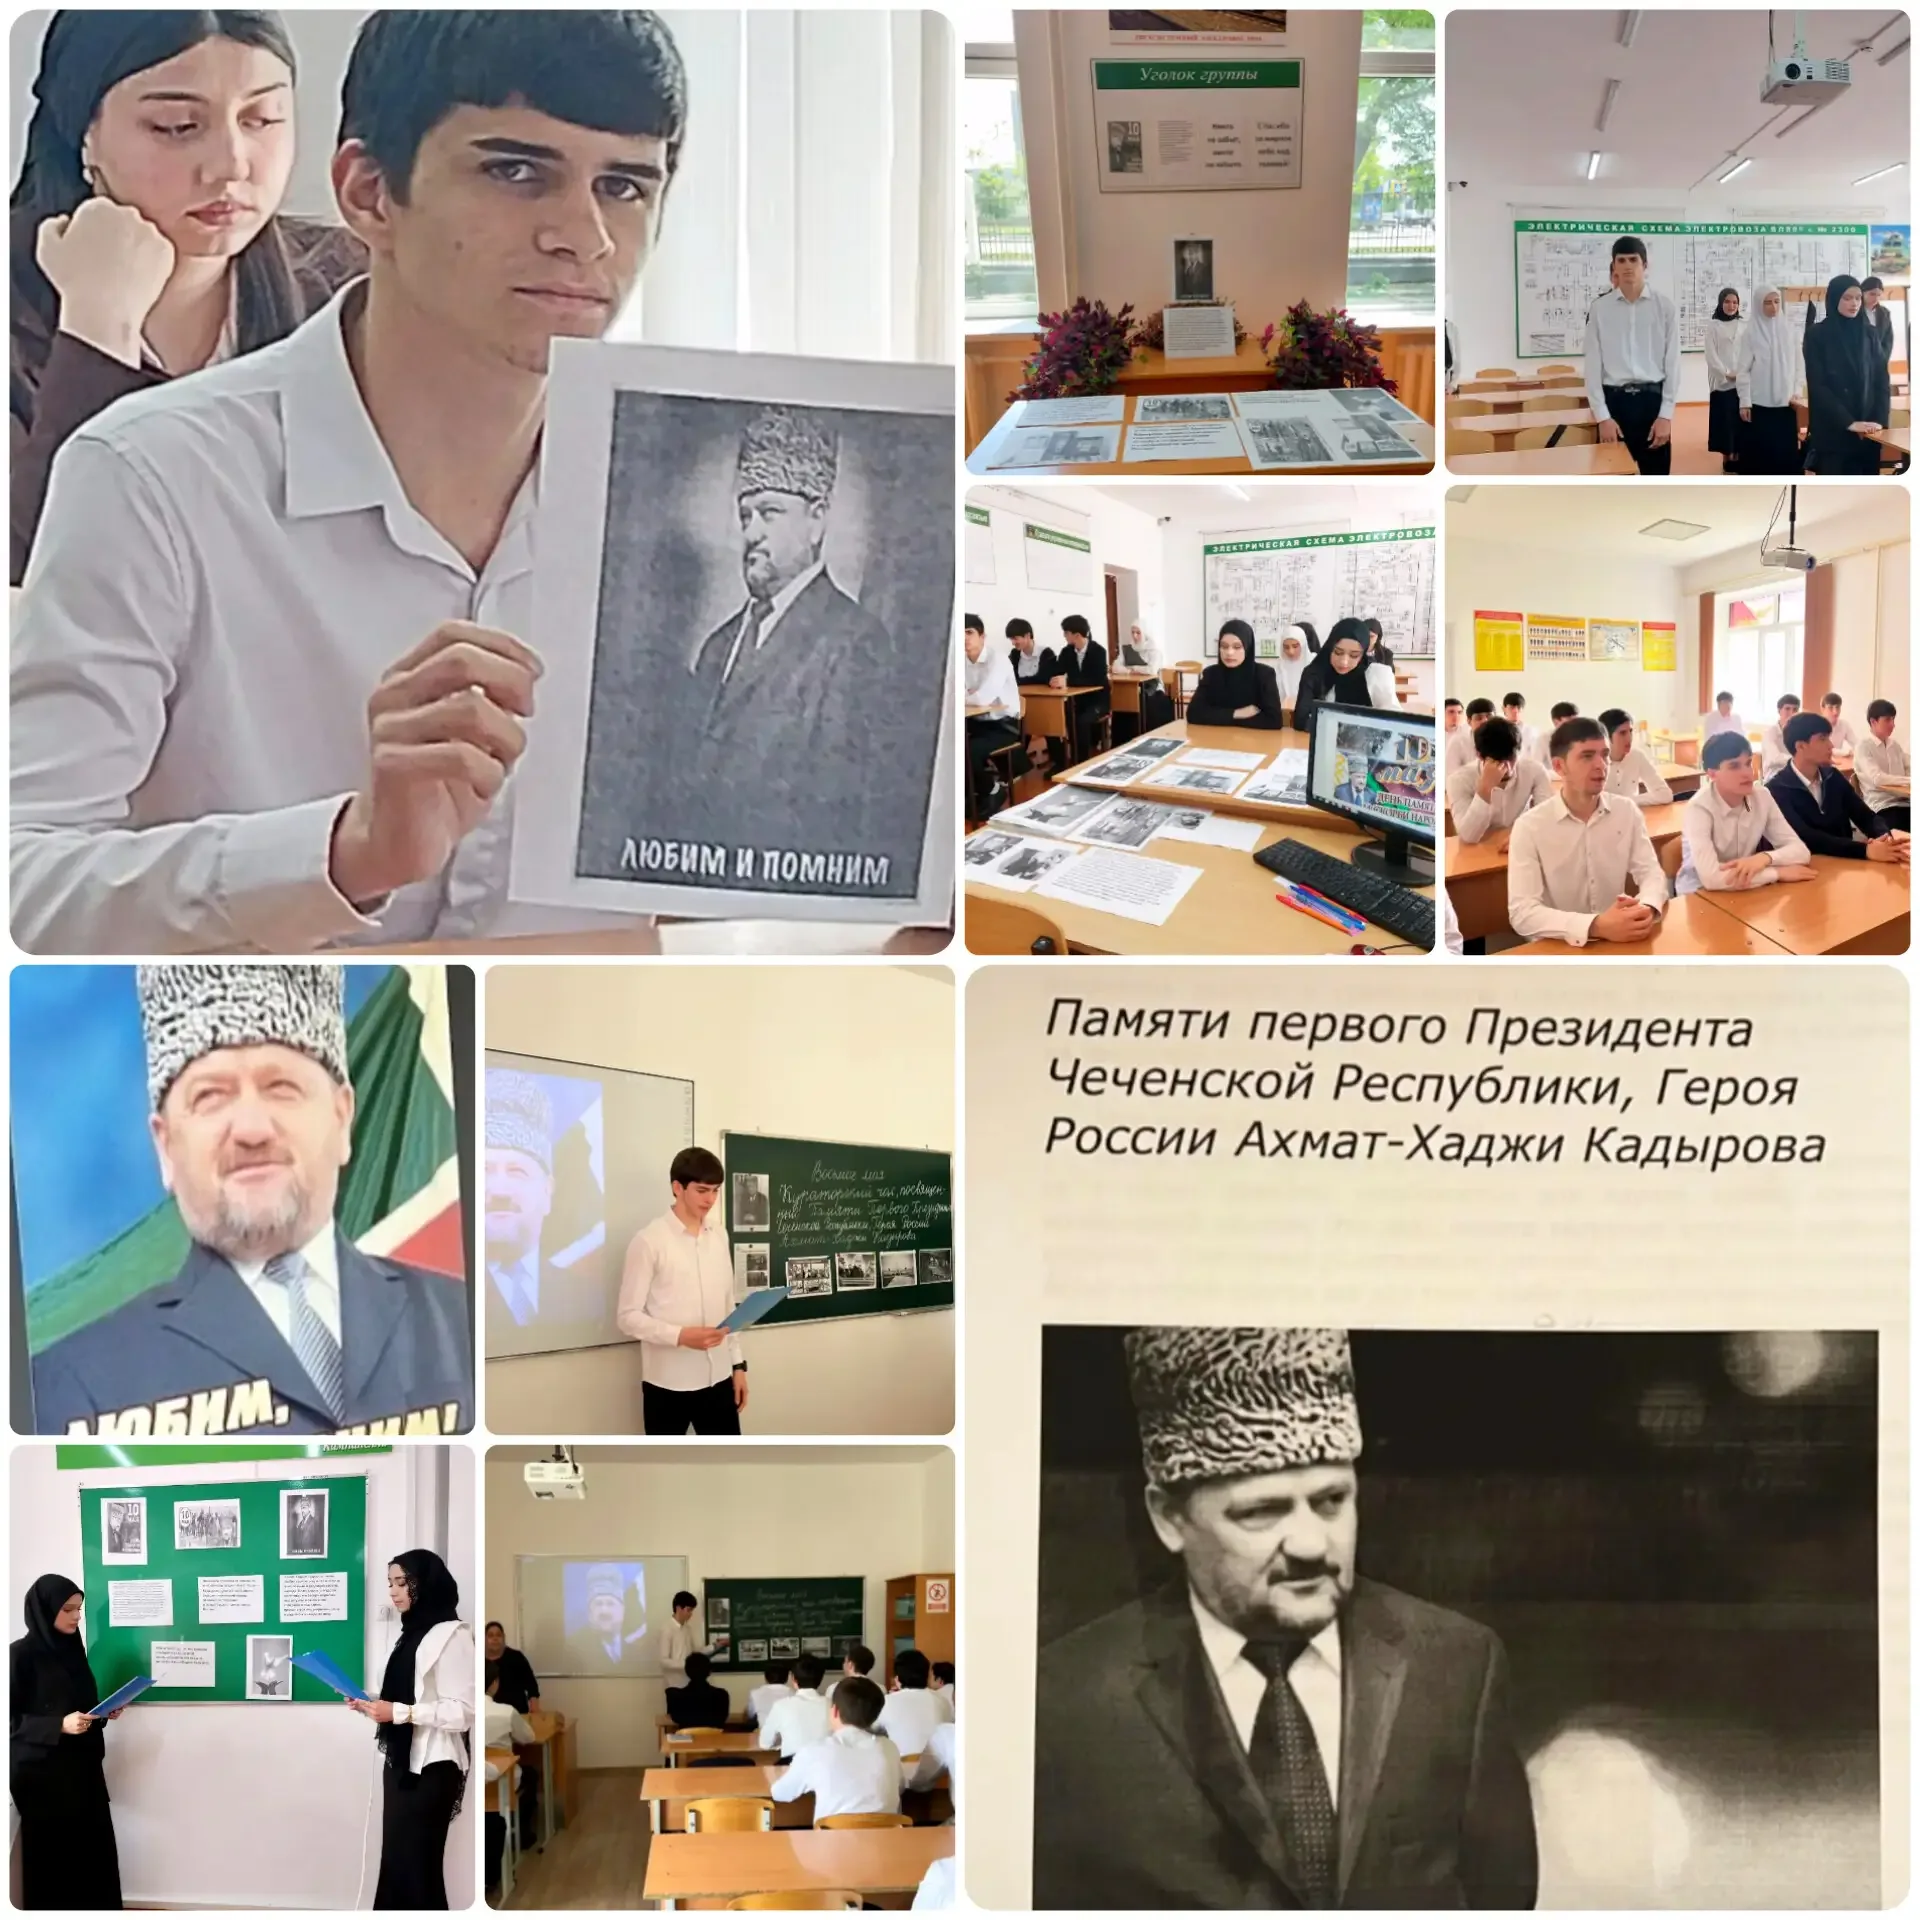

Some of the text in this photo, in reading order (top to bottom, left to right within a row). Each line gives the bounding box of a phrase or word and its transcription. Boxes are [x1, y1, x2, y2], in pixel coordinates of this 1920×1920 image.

[1140, 67, 1258, 83] Уголок группы
[1528, 222, 1634, 232] ЭЛЕКТРИЧЕСКАЯ
[1641, 224, 1681, 233] СХЕМА
[1685, 225, 1767, 233] ЭЛЕКТРОВОЗА
[1212, 539, 1300, 553] ЭЛЕКТРИЧЕСКАЯ
[1306, 535, 1345, 546] СХЕМА
[1378, 792, 1403, 807] ДЕНЬ
[620, 837, 890, 886] ЛЮБИМ И ПОМНИМ
[1046, 997, 1754, 1055] Памяти первого Президента
[1048, 1057, 1799, 1115] Чеченской Республики, Героя
[1045, 1116, 1828, 1173] России Ахмат-Хаджи Кадырова
[127, 1504, 140, 1516] 10
